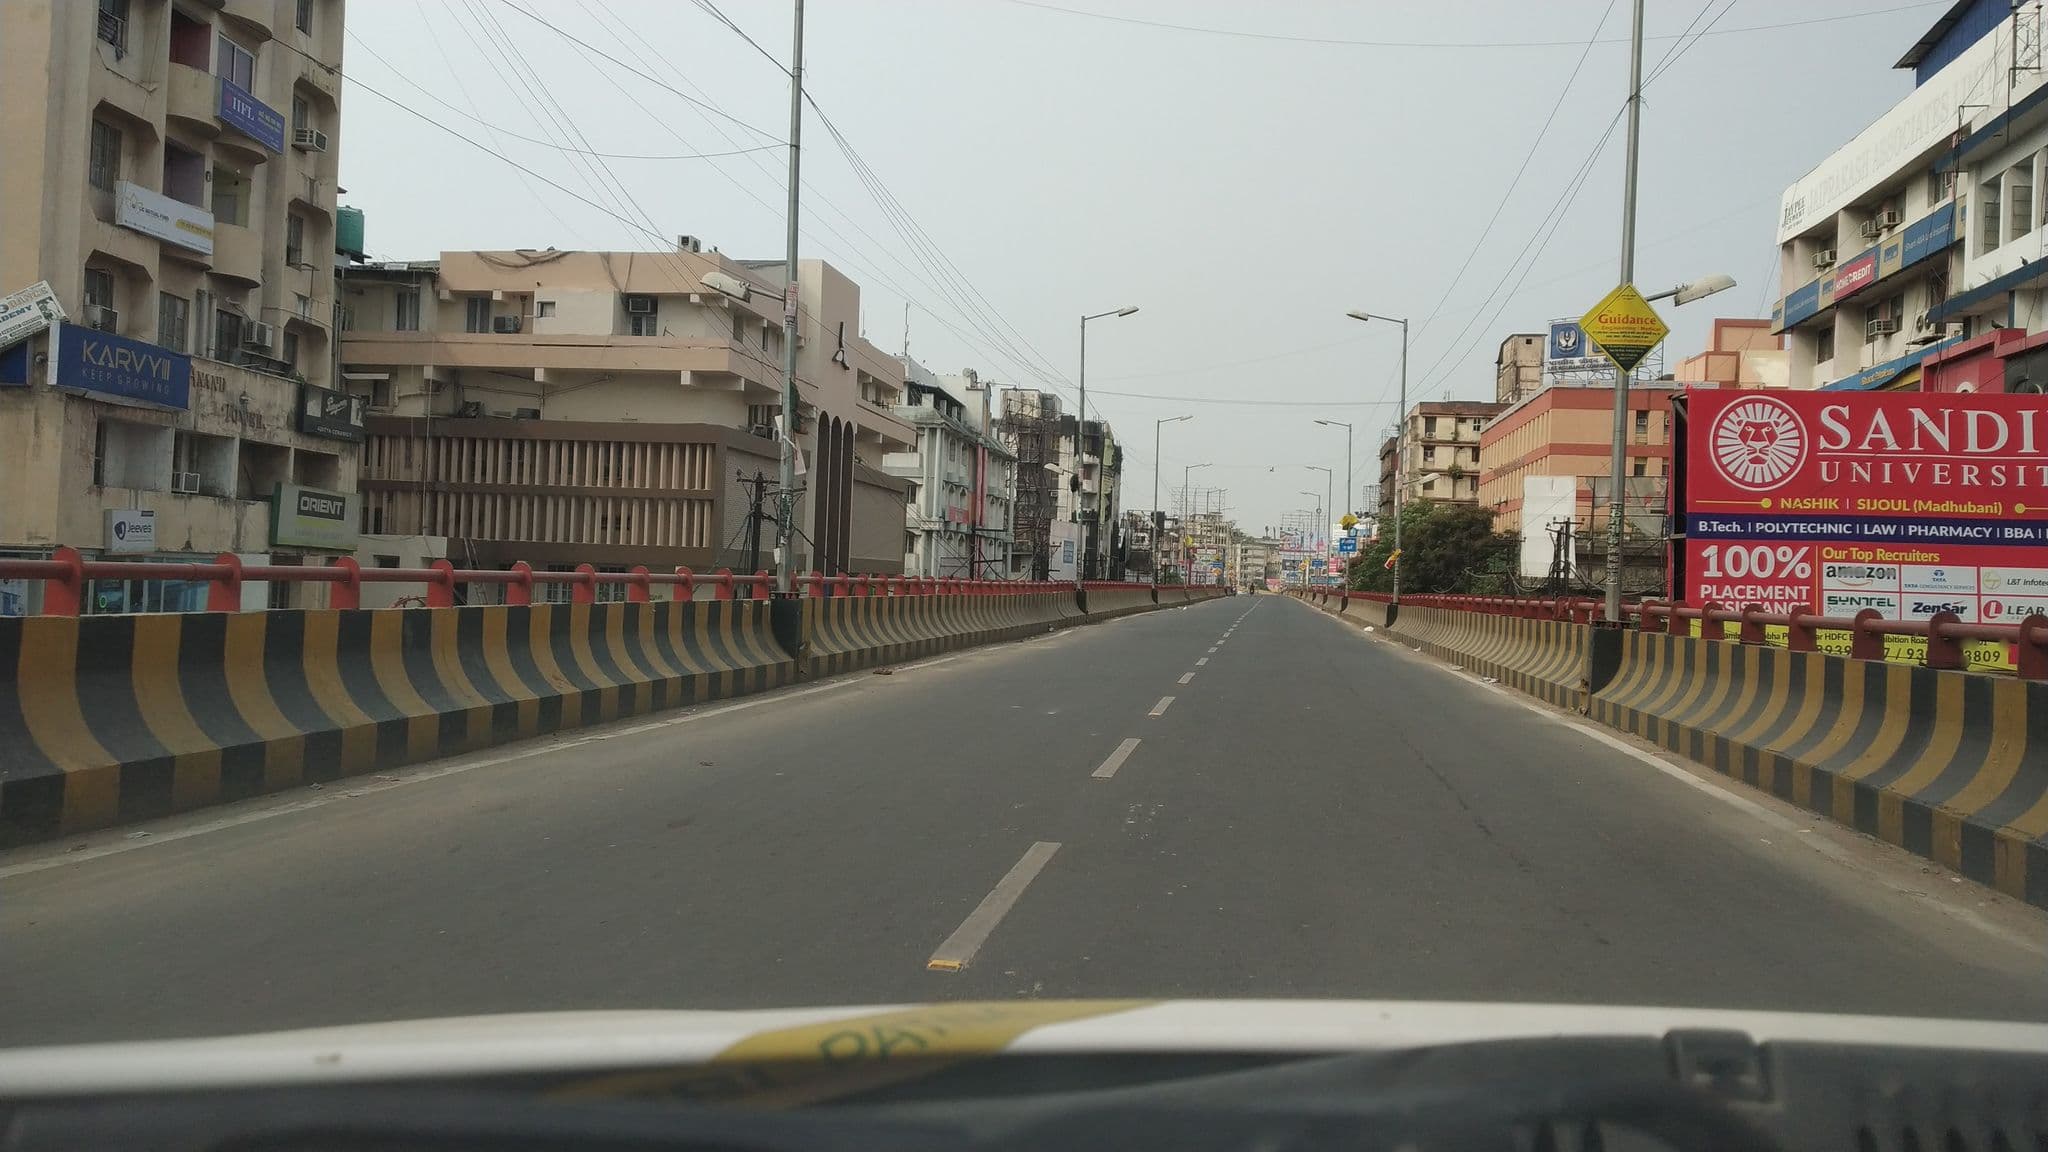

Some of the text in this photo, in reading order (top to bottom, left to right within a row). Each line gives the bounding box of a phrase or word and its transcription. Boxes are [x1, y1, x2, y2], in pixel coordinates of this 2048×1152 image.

[233, 97, 255, 121] IIFL
[0, 304, 32, 323] DEMY
[1599, 313, 1657, 325] Guidance
[83, 340, 162, 378] KARVY
[81, 366, 112, 382] KEEP
[1819, 405, 2048, 453] SANDI
[300, 496, 343, 515] ORIENT
[1780, 498, 2003, 516] NASHIK SIJOUL (Madhubani)
[128, 521, 152, 534] Jeeves
[1699, 520, 2034, 539] B.Tech. POLYTECHNIC LAW PHARMACY BBA
[1701, 544, 1812, 579] 100%
[1823, 547, 1940, 563] Our Top Recruiters
[2007, 578, 2021, 586] L&T
[1700, 584, 1810, 601] PLACEMENT
[1704, 600, 1811, 614] SISANC
[1827, 596, 1897, 608] SYNTEL
[2007, 605, 2045, 616] LEAR
[1825, 633, 1847, 641] HDFC
[1884, 635, 1908, 643] ibition
